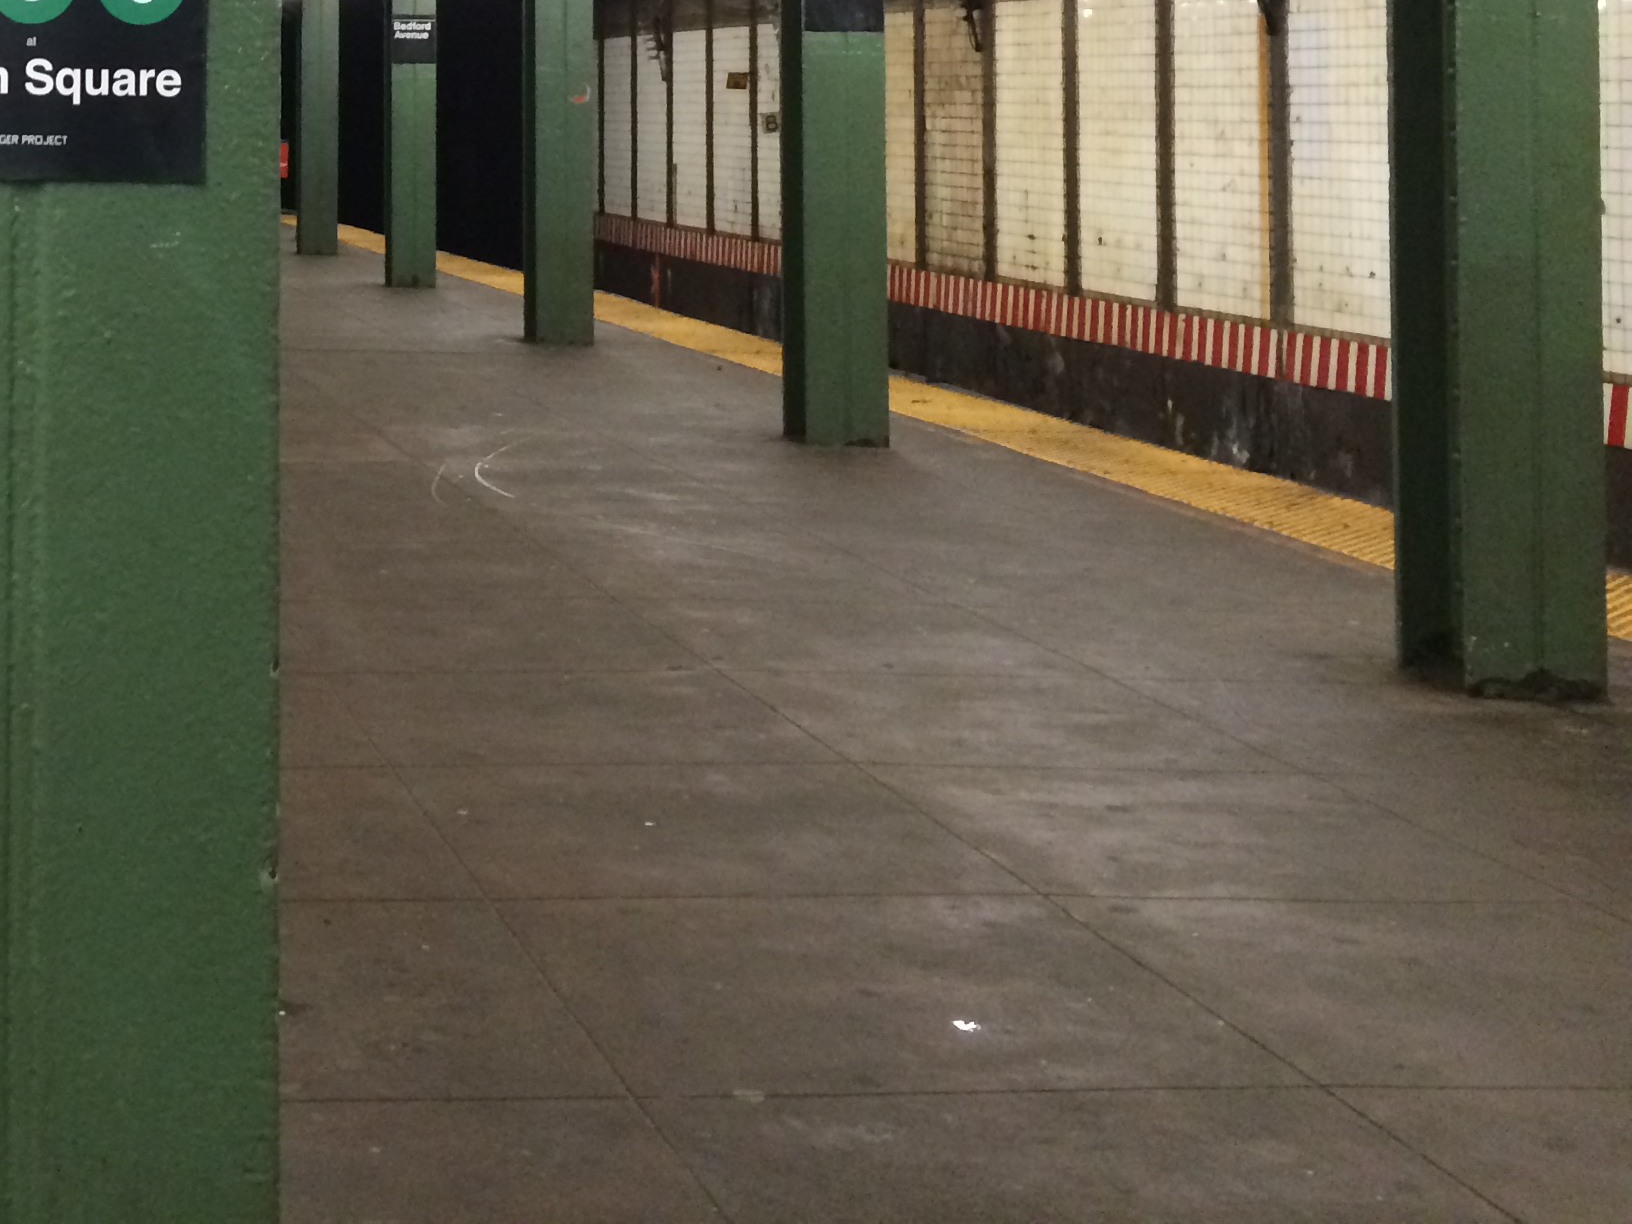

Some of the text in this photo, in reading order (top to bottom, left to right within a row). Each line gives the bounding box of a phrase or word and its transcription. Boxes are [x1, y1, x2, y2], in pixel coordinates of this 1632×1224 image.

[26, 36, 37, 47] at
[24, 58, 182, 105] Square
[21, 134, 69, 146] PROJECT
